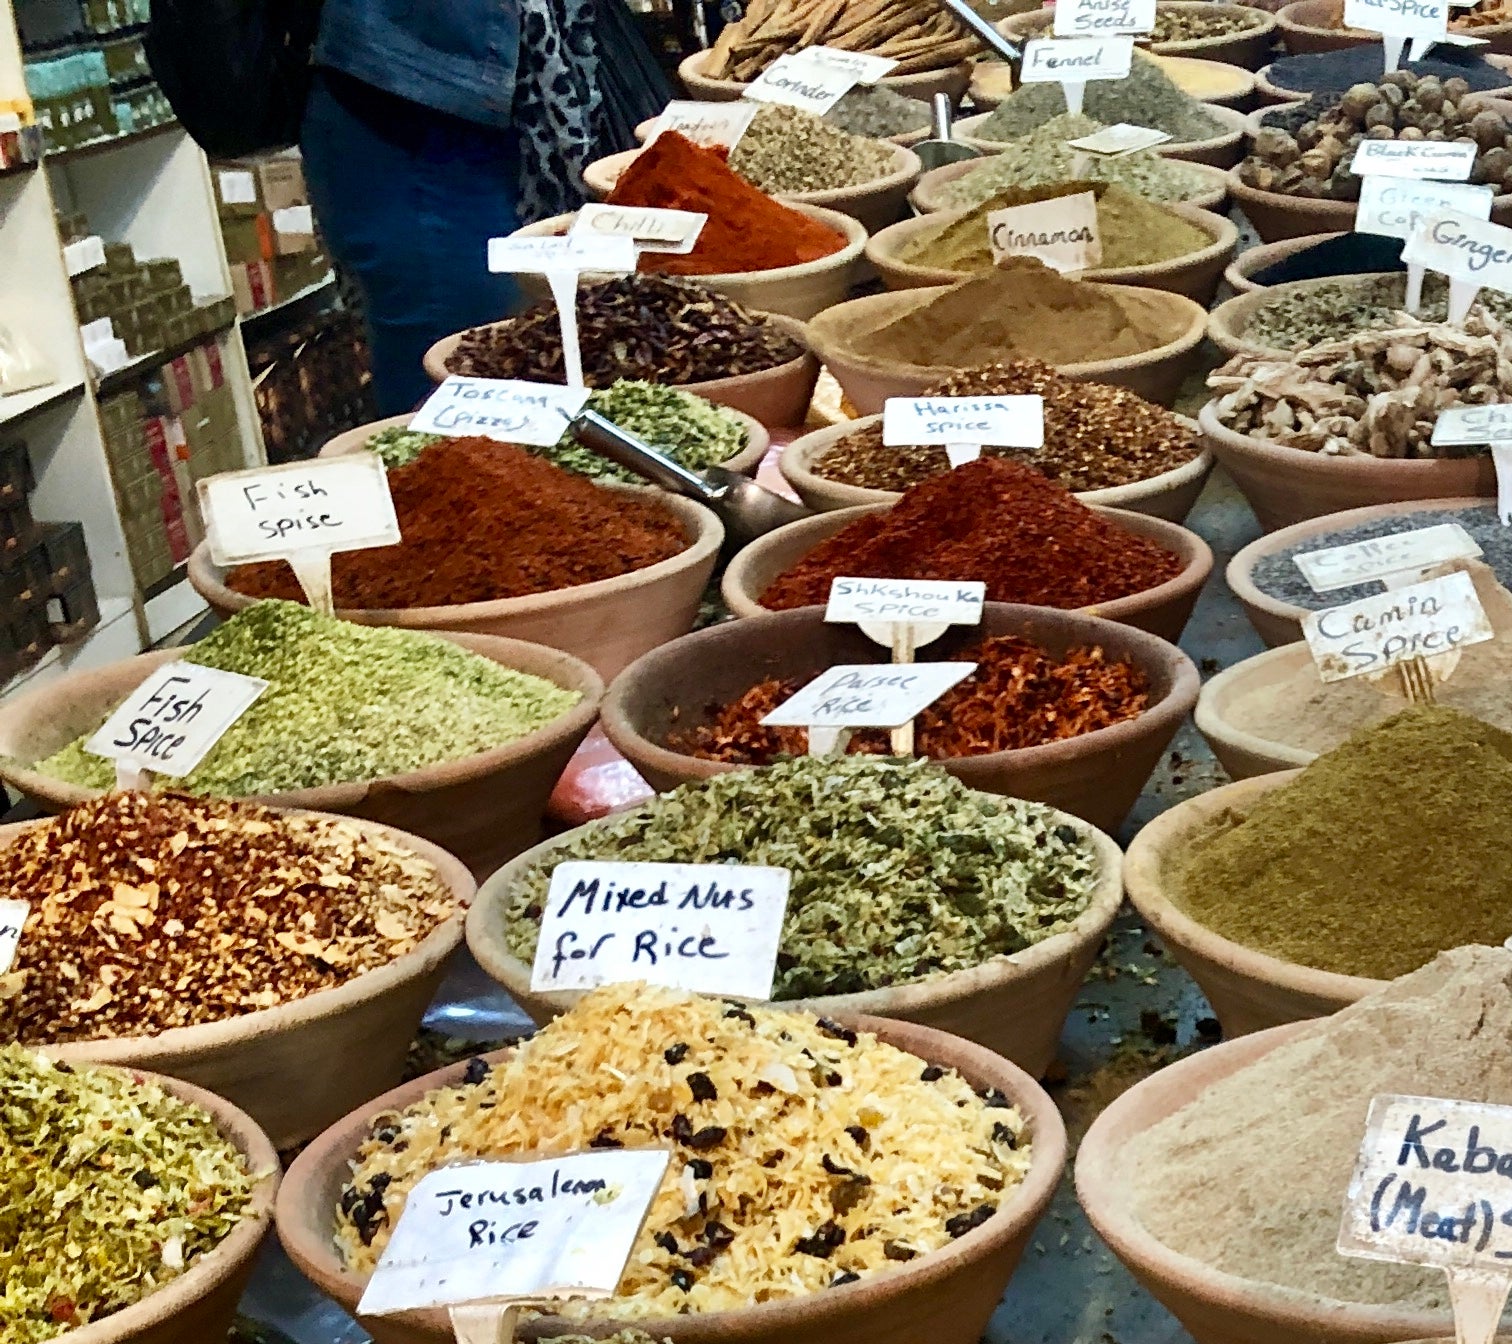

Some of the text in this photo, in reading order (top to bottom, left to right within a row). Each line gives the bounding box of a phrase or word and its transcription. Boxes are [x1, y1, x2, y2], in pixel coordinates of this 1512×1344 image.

[1033, 48, 1103, 69] Fennel
[243, 479, 329, 511] Fish
[139, 676, 212, 723] Fish
[556, 878, 669, 918] Mixed
[552, 926, 730, 978] for Rice
[469, 1219, 539, 1248] Rice
